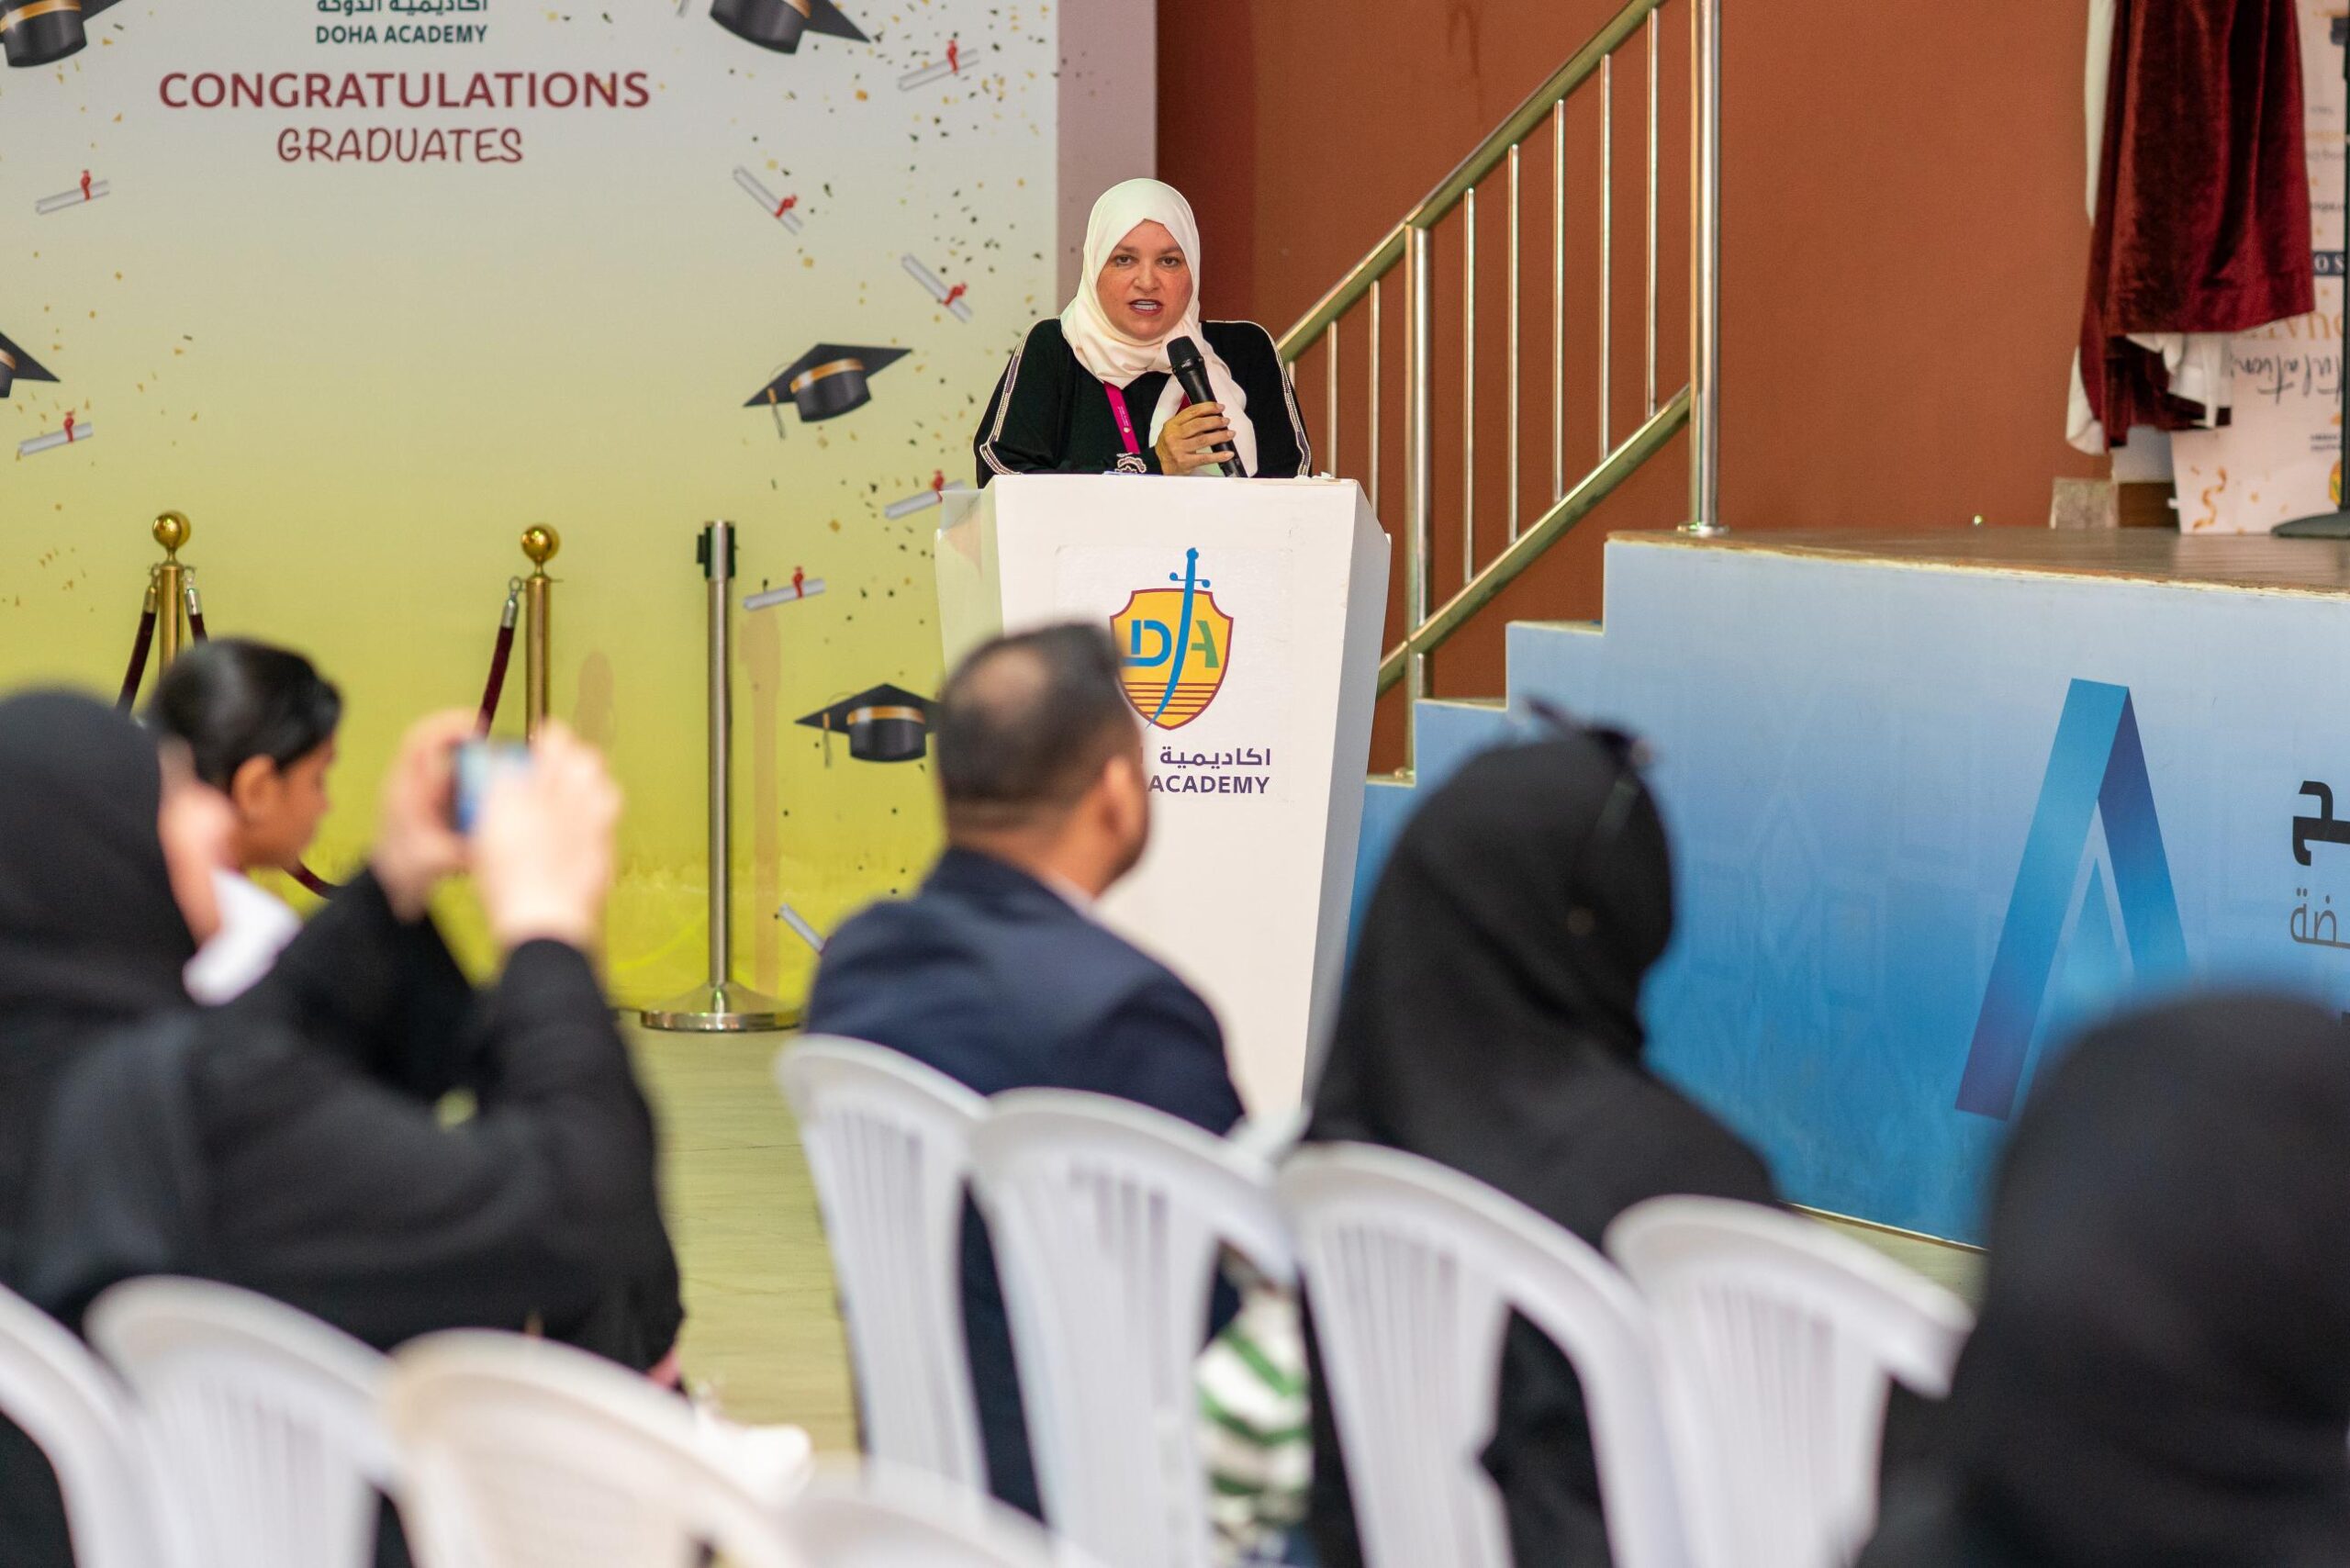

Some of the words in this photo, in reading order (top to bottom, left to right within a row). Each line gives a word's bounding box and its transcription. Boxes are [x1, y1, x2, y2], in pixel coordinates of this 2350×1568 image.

[316, 25, 377, 44] DOHA
[384, 25, 487, 44] ACADEMY
[159, 71, 650, 108] CONGRATULATIONS
[277, 127, 523, 163] GRADUATES
[1159, 745, 1270, 769] اكاديمية
[1147, 774, 1270, 795] ACADEMY
